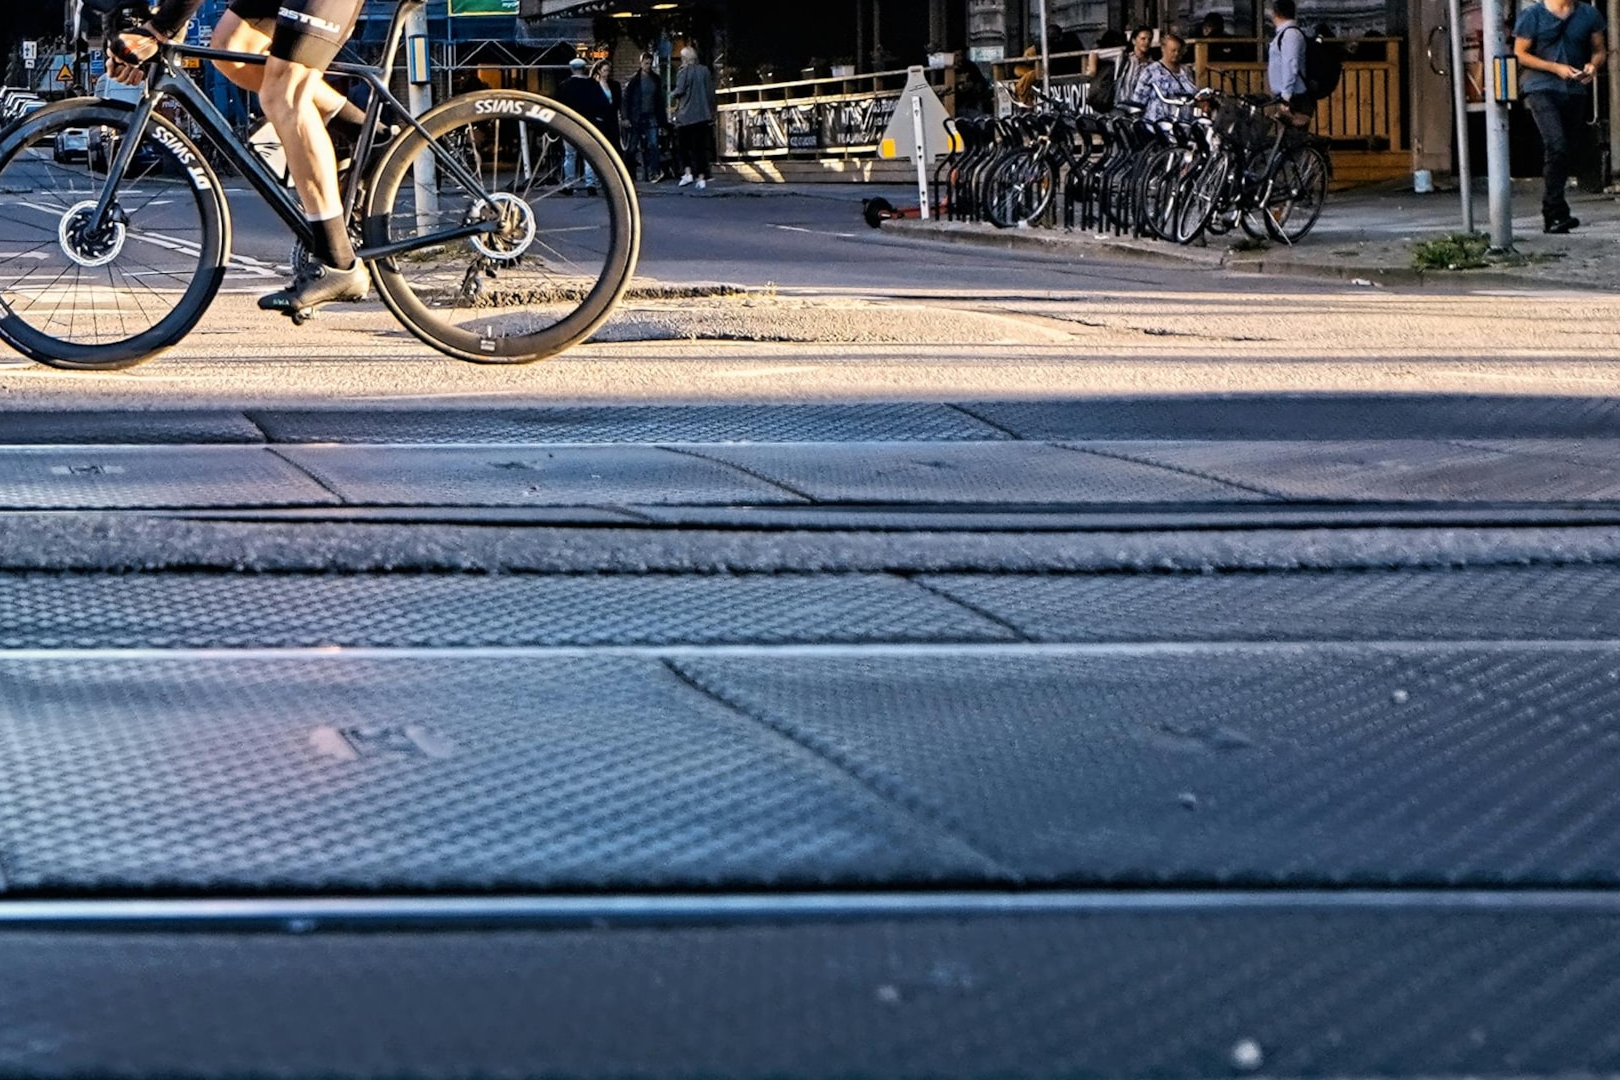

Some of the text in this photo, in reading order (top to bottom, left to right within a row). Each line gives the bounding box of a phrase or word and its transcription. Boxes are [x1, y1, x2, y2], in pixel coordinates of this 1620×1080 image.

[474, 100, 557, 123] DT SWISS
[151, 126, 212, 190] DT SWISS
